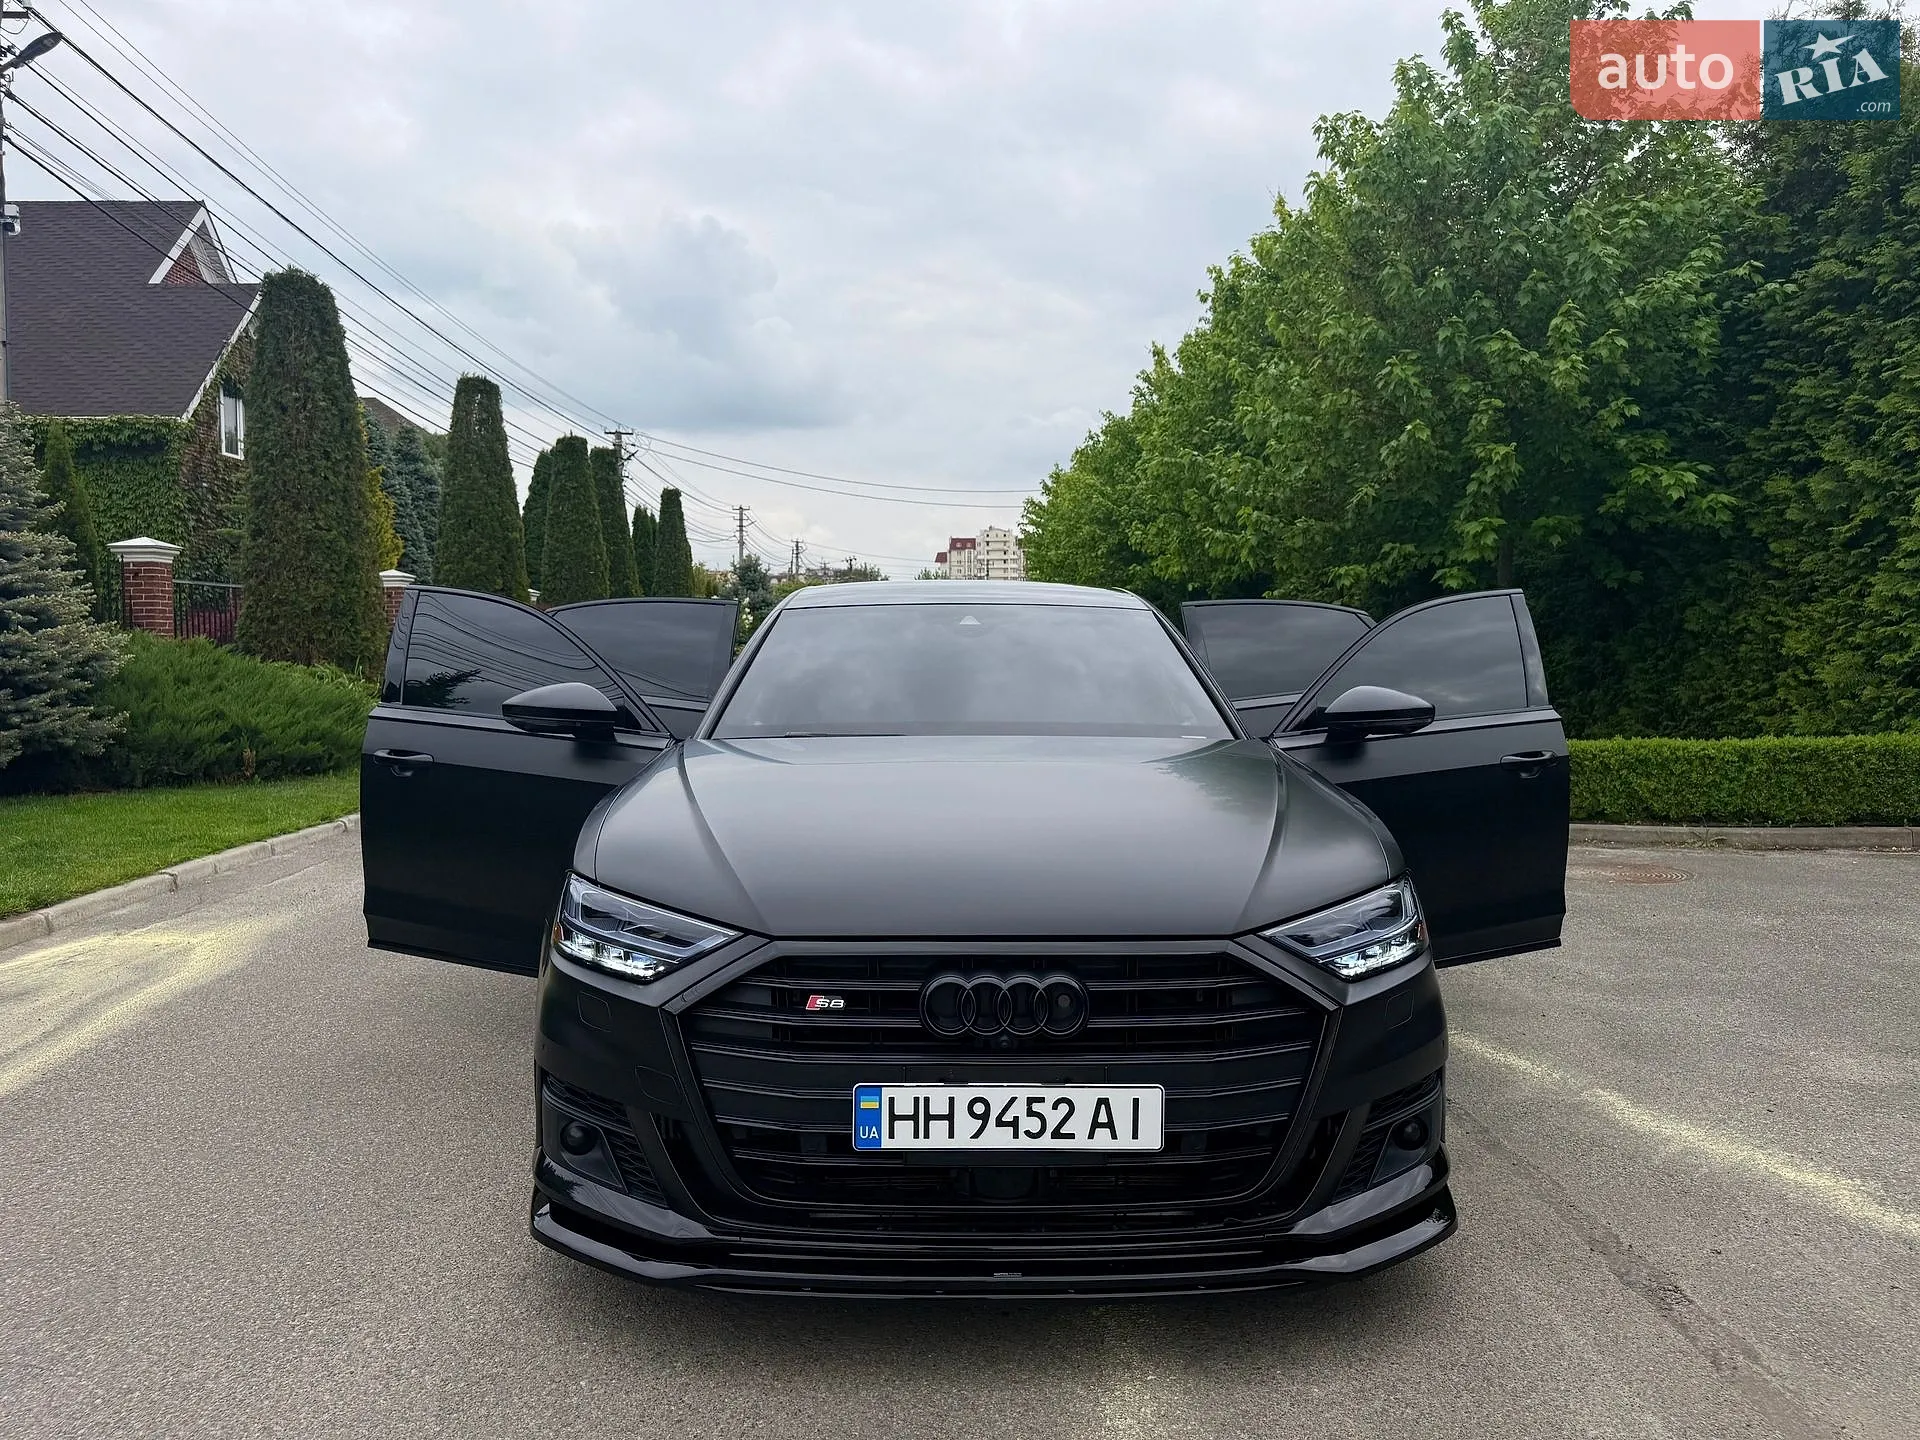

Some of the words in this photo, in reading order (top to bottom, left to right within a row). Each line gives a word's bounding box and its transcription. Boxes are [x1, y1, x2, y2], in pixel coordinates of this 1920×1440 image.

[813, 998, 845, 1009] S8
[887, 1096, 955, 1140] HH
[966, 1096, 1076, 1140] 9452
[1087, 1097, 1139, 1140] AI
[859, 1125, 879, 1139] UA
